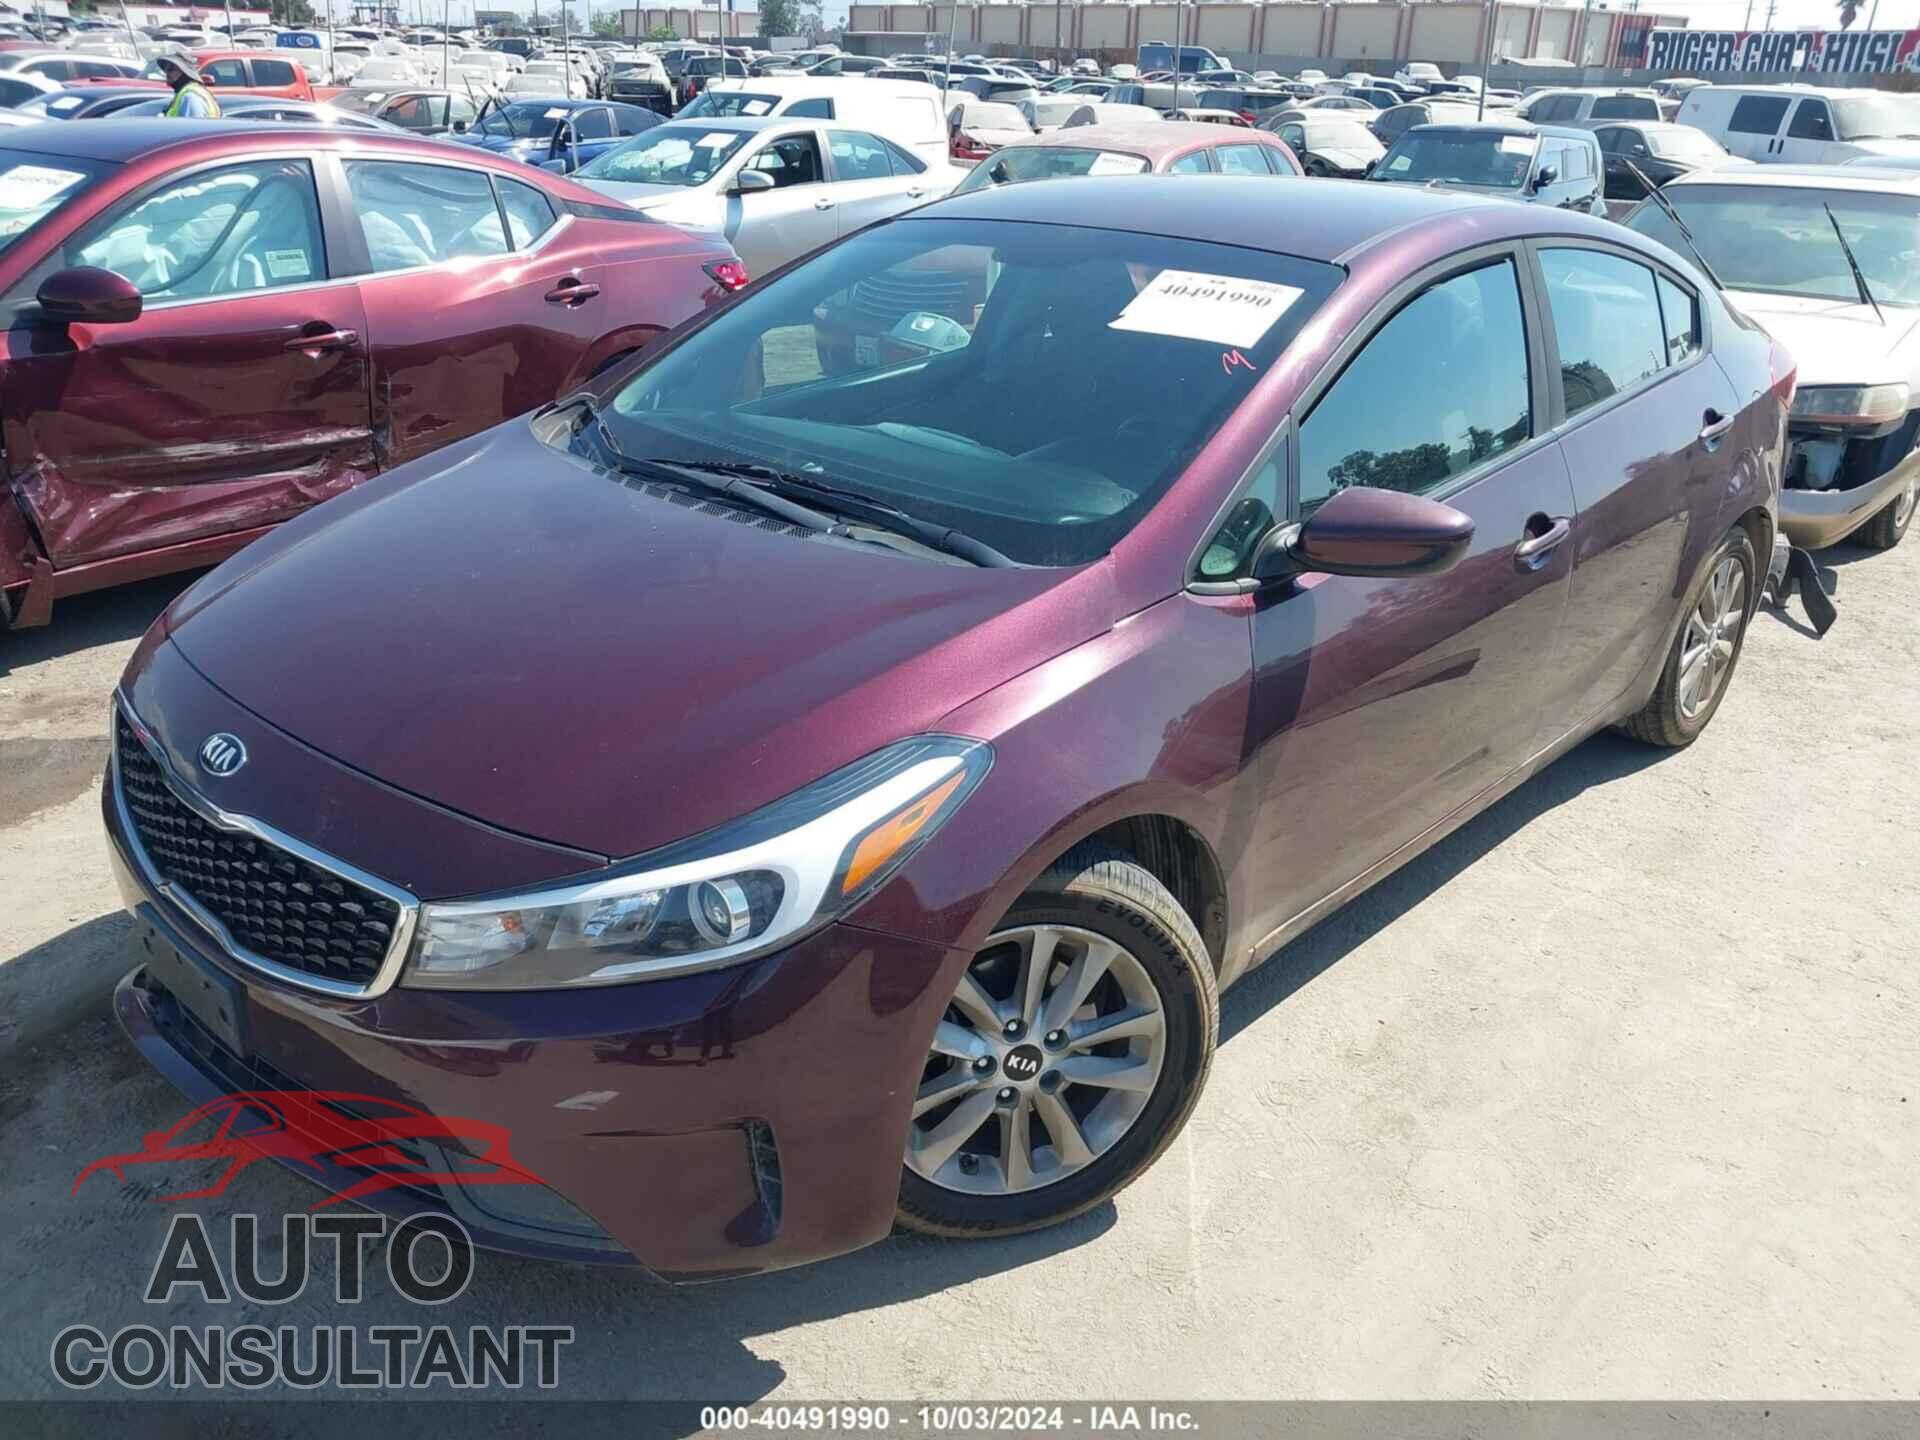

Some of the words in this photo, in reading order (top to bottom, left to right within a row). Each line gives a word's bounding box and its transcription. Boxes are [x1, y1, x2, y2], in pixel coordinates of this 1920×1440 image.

[1159, 283, 1273, 308] 40491990
[201, 735, 238, 771] KIA
[1007, 1053, 1039, 1073] KIA
